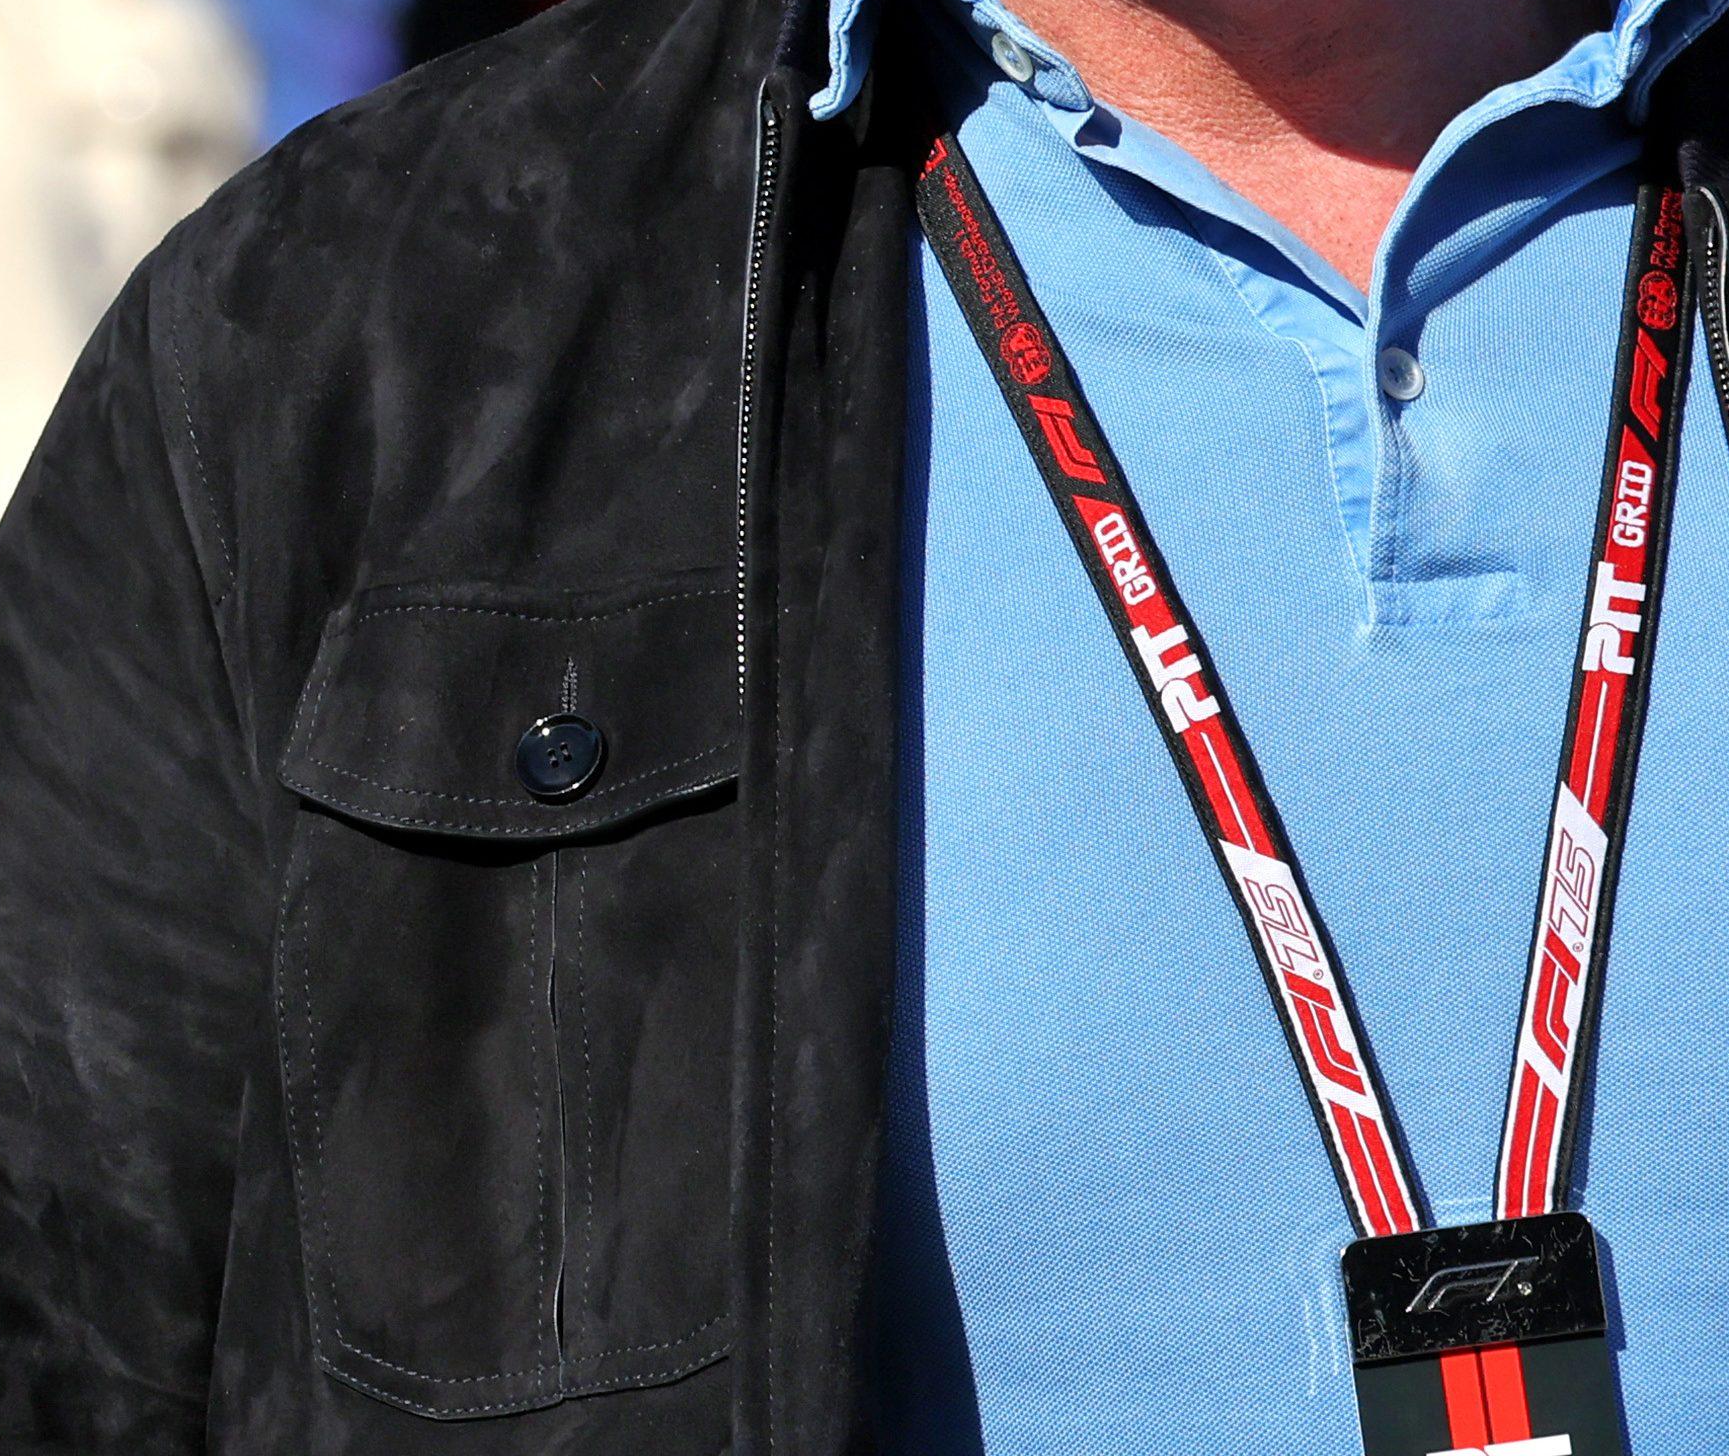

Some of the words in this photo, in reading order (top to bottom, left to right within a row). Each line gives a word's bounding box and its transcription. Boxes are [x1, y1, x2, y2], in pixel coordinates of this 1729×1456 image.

[1629, 327, 1668, 441] F1
[1027, 395, 1107, 484] F1
[1612, 459, 1652, 547] GRID
[1094, 512, 1156, 605] GRID
[1582, 560, 1646, 675] PIT
[1130, 624, 1221, 734] PIT
